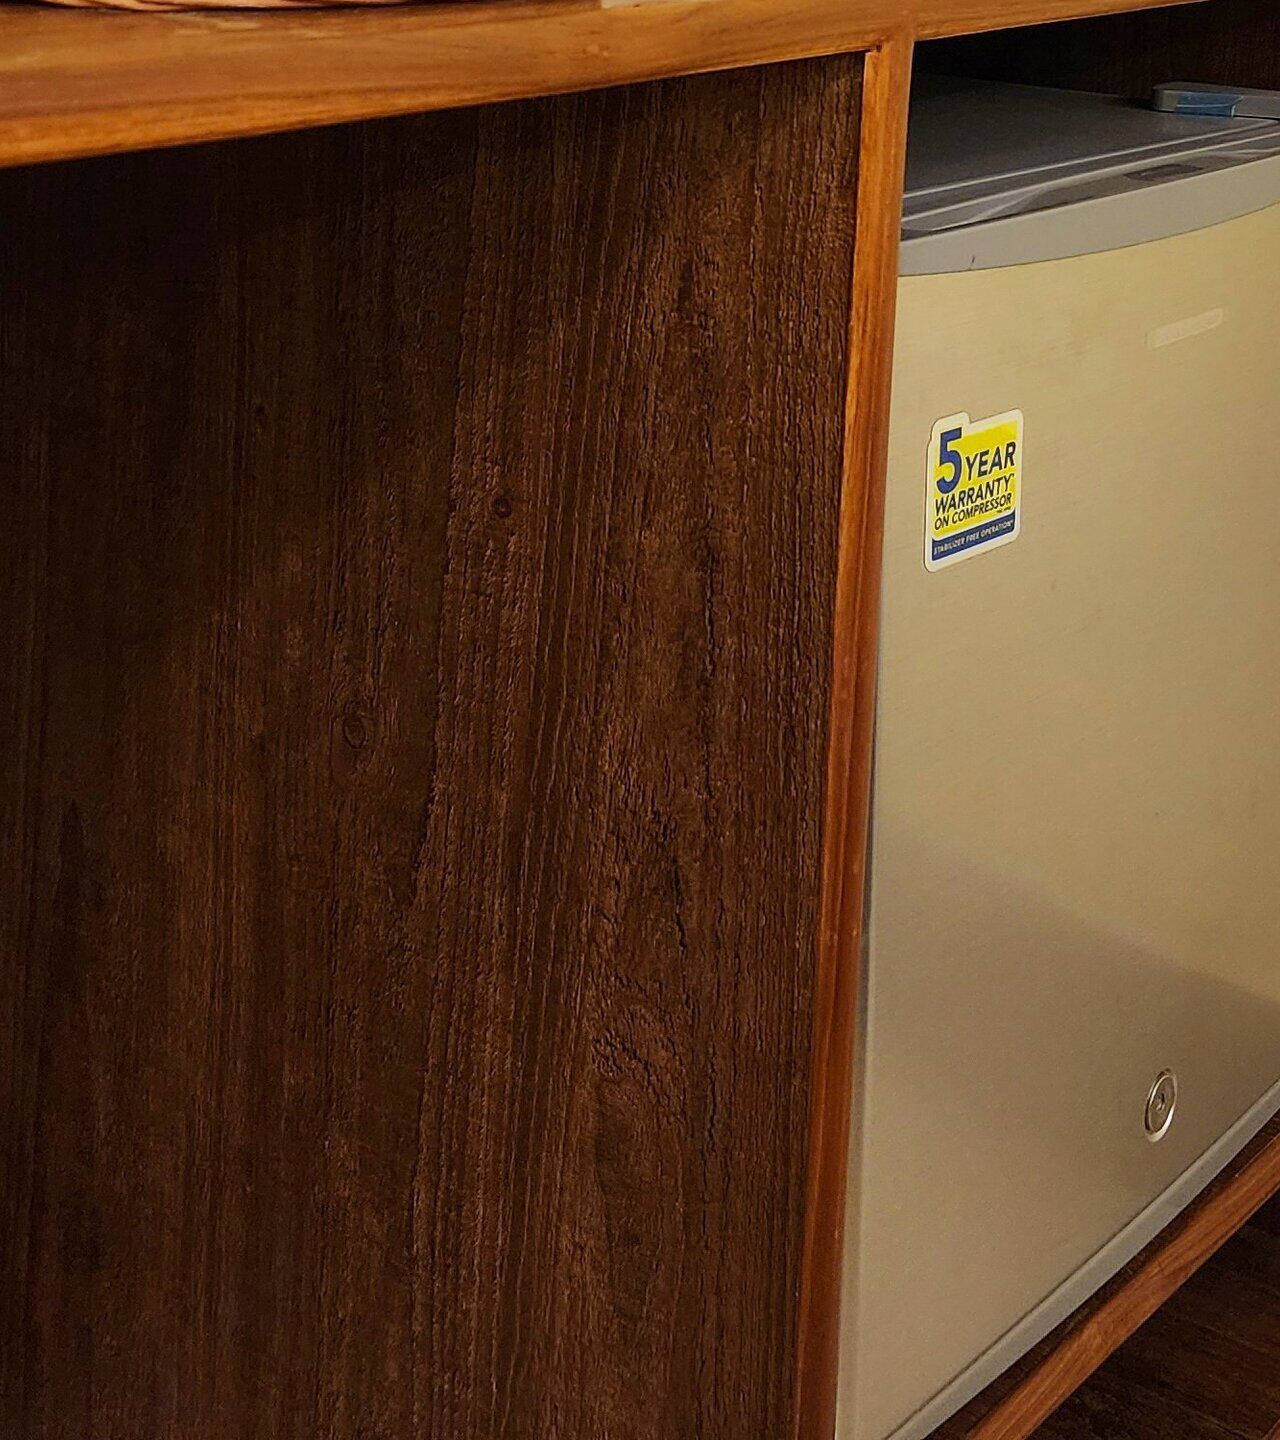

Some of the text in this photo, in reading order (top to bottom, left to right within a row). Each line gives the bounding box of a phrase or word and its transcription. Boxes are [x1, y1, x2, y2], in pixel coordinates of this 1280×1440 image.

[936, 427, 1017, 495] 5 YEAR
[934, 492, 1013, 531] ON COMPRESSOR
